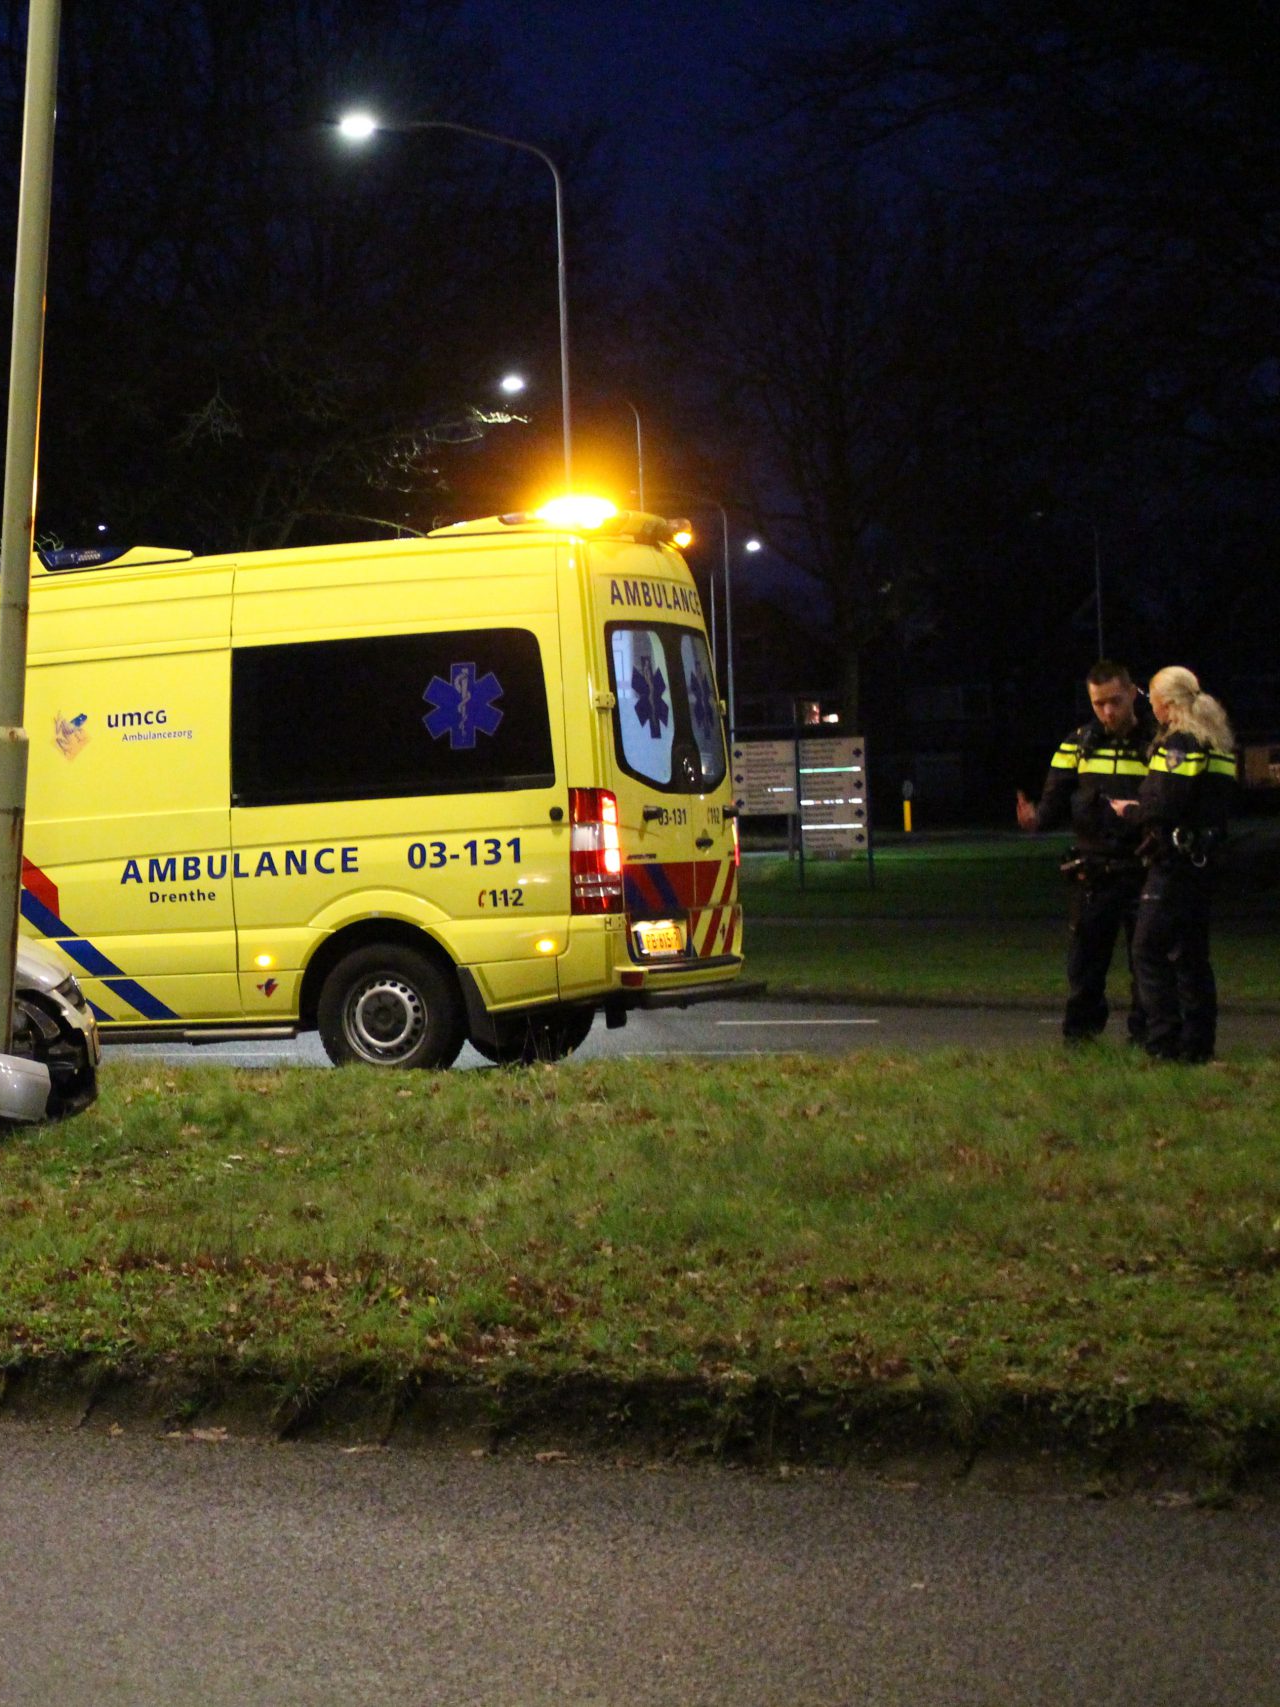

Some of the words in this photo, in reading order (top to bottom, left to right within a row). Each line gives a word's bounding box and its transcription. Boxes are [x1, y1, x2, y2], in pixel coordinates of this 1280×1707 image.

[121, 730, 193, 742] Ambulancezorg
[407, 837, 521, 869] 03-131
[120, 846, 360, 885] AMBULANCE
[149, 889, 216, 903] Drenthe
